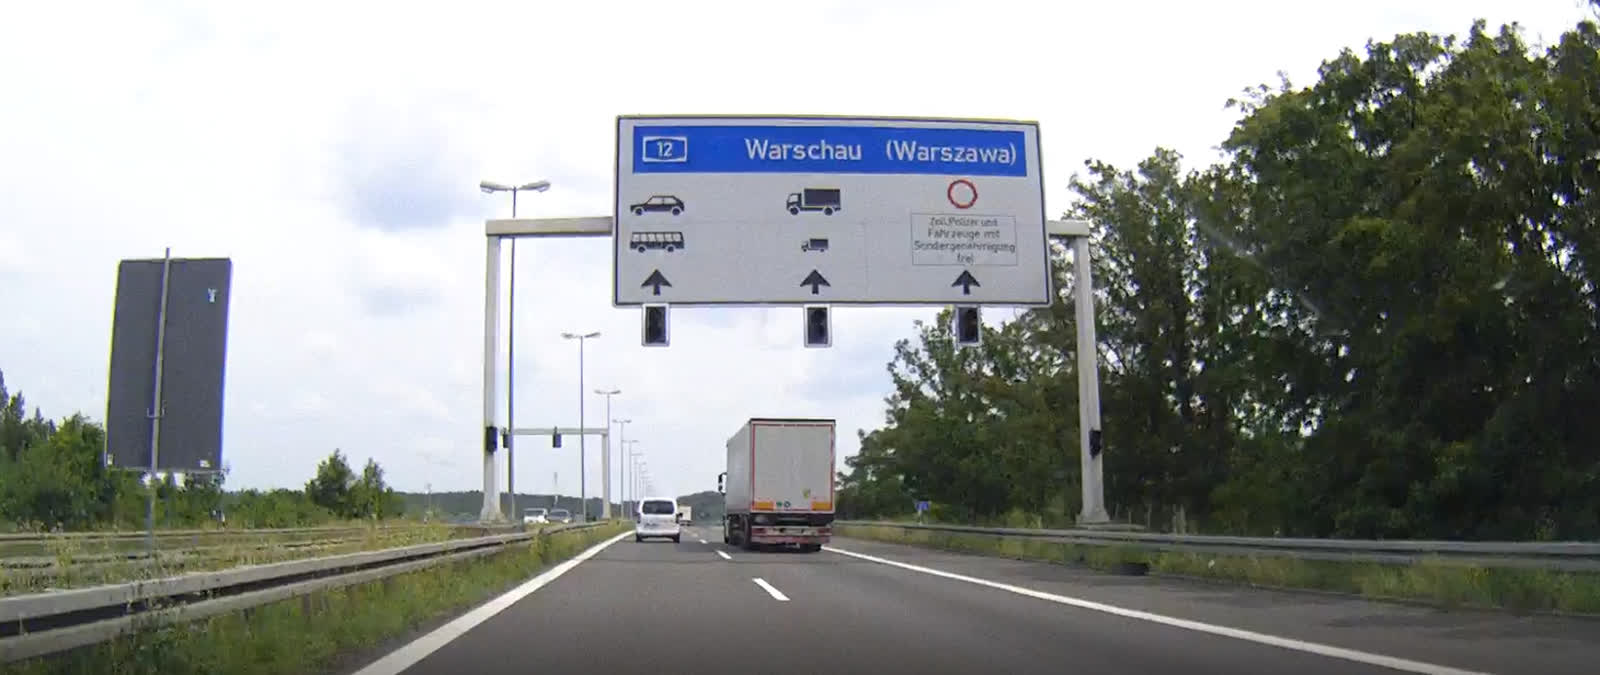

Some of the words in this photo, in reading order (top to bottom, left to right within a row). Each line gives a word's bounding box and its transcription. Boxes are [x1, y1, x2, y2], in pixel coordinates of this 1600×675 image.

[656, 141, 673, 158] 12
[745, 138, 863, 161] Warschau
[886, 139, 1017, 165] (Warszawa)
[928, 228, 980, 240] Fahrzeuge
[983, 230, 1000, 239] mit
[957, 253, 974, 264] frei
